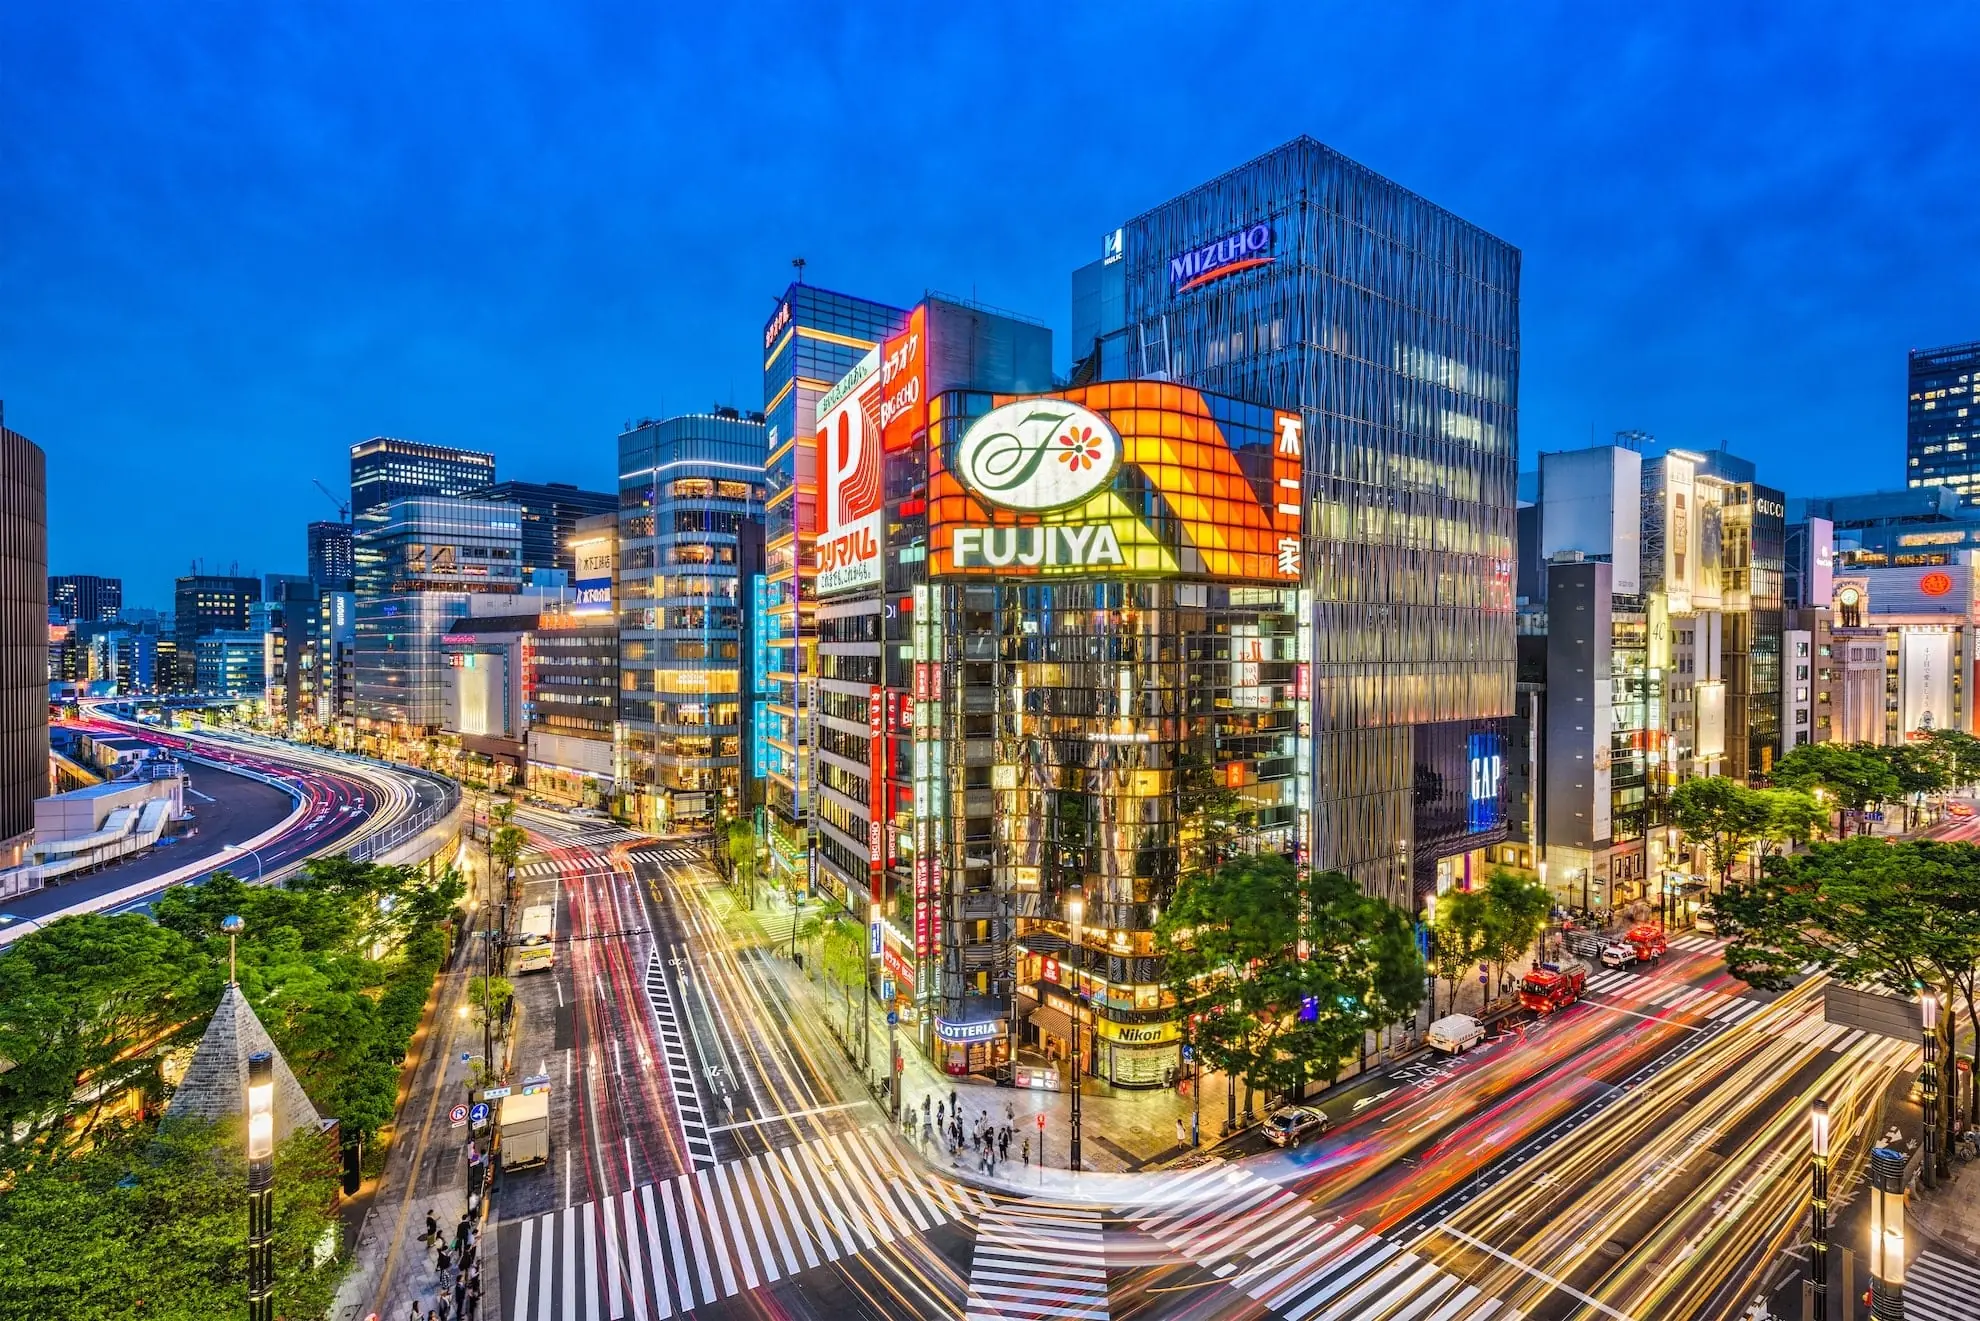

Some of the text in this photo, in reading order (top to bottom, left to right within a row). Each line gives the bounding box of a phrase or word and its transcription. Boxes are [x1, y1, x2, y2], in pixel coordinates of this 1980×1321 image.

[1103, 252, 1123, 266] HULIC
[1170, 224, 1270, 285] MIZUHO
[881, 333, 919, 388] カラオケ
[881, 375, 920, 430] BIG ECHO
[1277, 415, 1302, 576] 不二家
[1757, 497, 1785, 519] GUCCI
[815, 527, 878, 574] プリマハム
[951, 525, 1124, 568] FUJIYA
[821, 562, 871, 588] これまでも、これからも。
[871, 692, 881, 738] カラオケ
[888, 692, 896, 733] カラオ
[1471, 755, 1501, 801] GAP
[871, 820, 881, 861] BIG ECHO
[940, 1023, 996, 1038] LOTTERIA
[1118, 1027, 1162, 1042] Nikon
